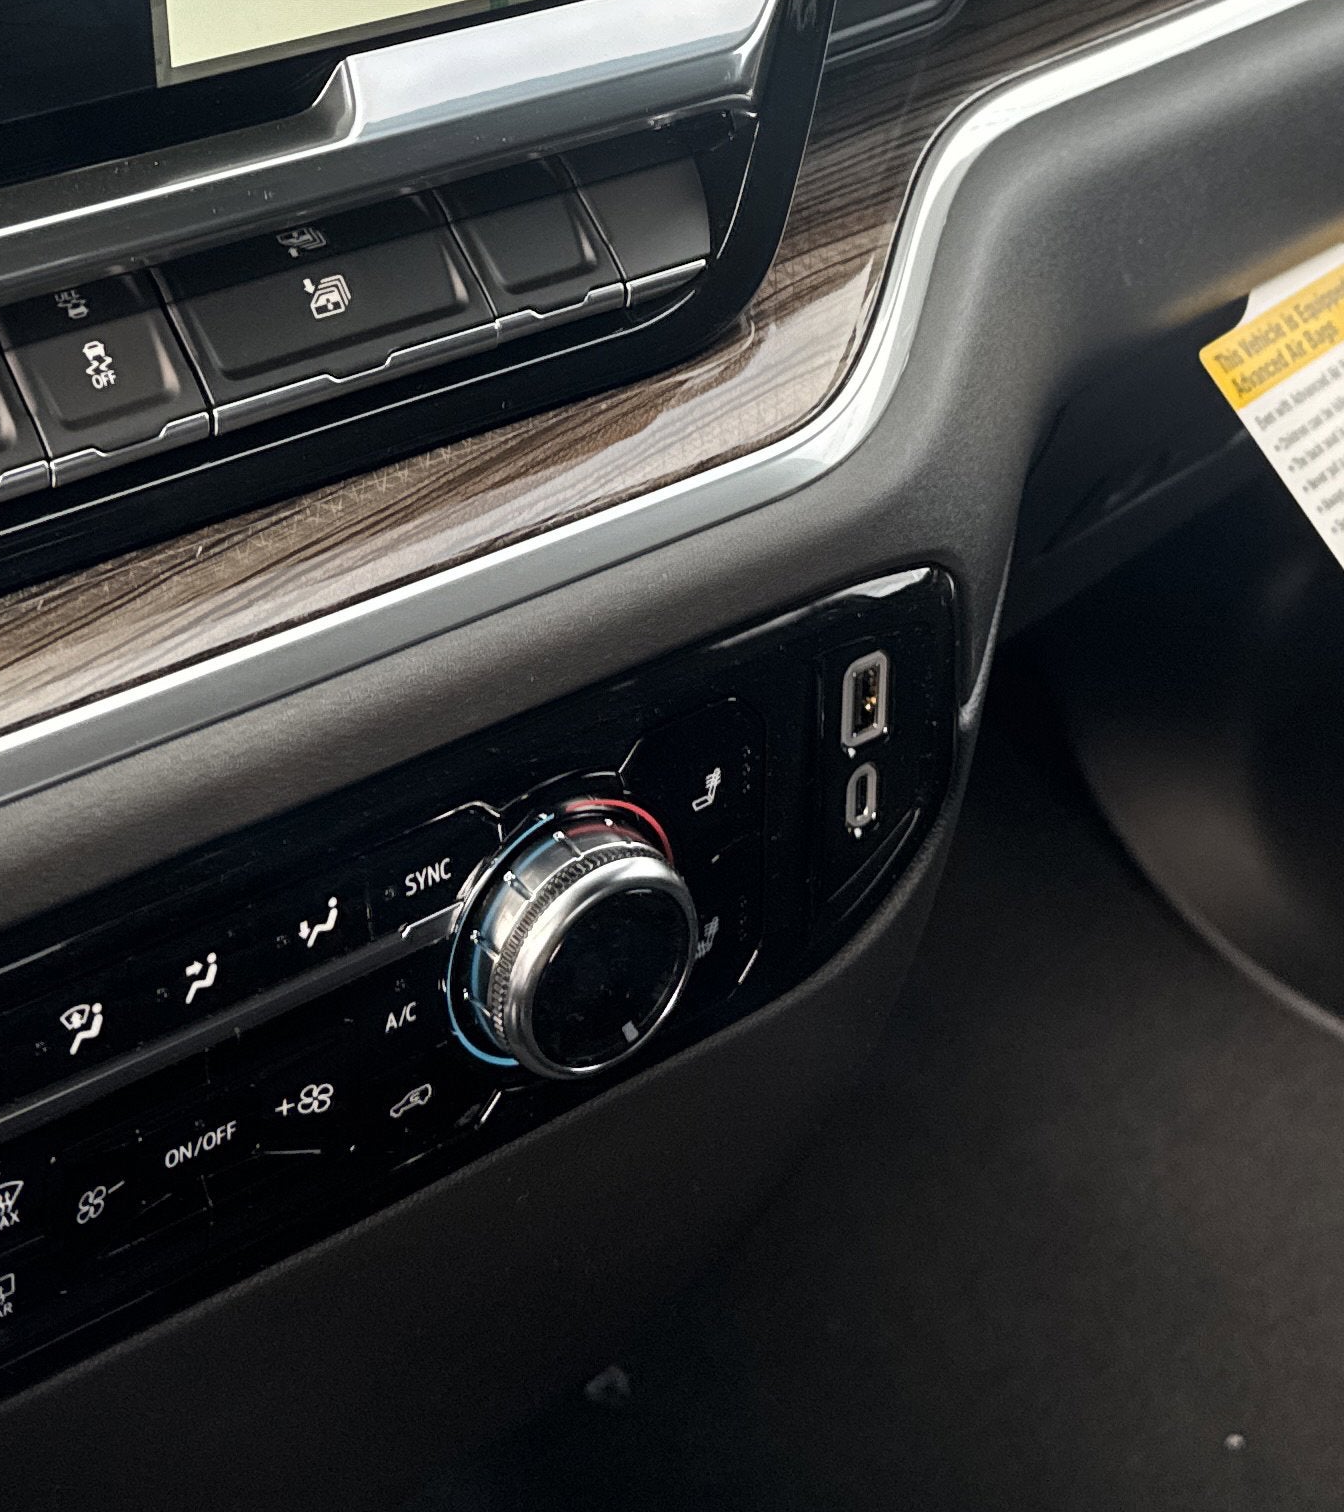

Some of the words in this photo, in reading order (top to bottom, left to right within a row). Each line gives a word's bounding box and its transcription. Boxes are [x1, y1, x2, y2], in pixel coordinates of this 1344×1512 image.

[1212, 349, 1244, 374] This
[92, 369, 116, 389] OFF
[404, 858, 452, 896] SYNC
[385, 1001, 417, 1033] A/C
[164, 1121, 237, 1169] ON/OFF
